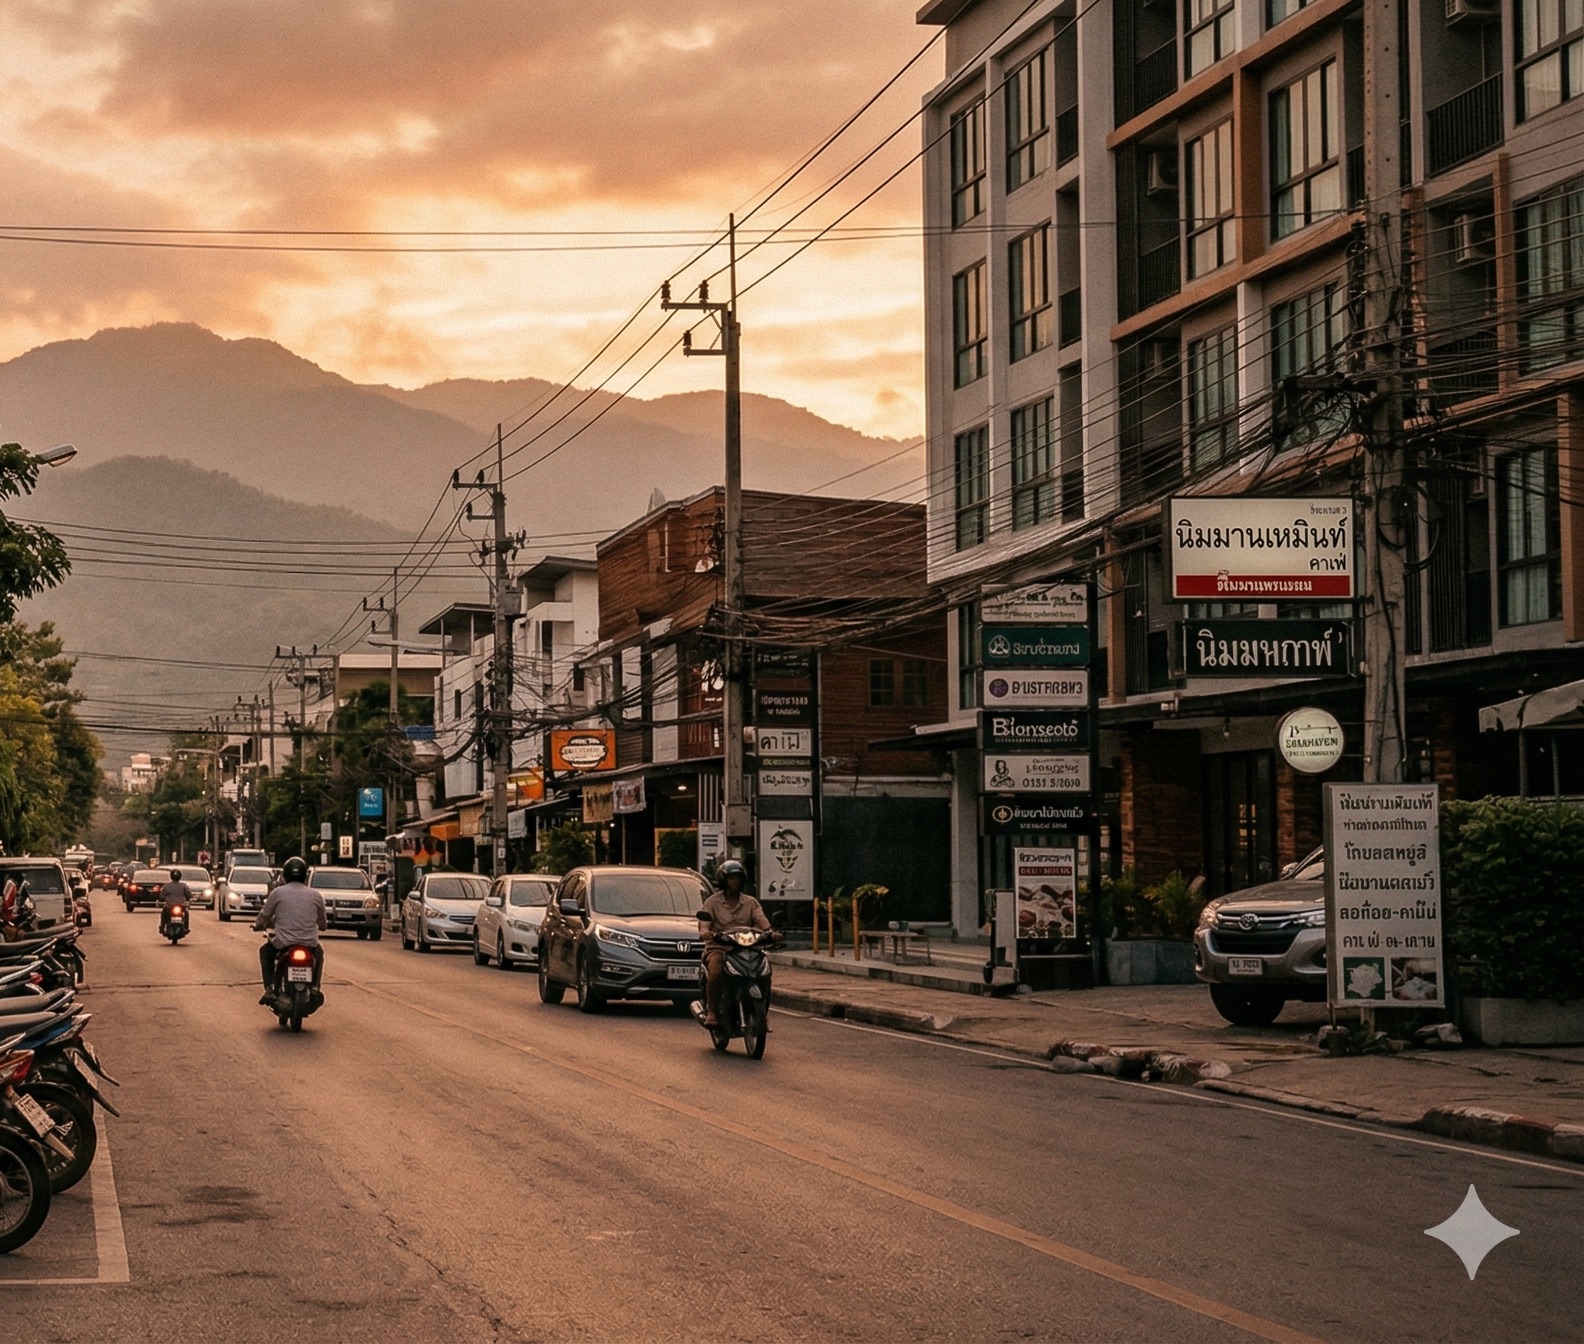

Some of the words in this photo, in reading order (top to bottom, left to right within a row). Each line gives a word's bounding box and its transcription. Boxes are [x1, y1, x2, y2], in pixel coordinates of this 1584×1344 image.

[1175, 517, 1348, 548] นิมมานเหมินท์
[1309, 552, 1347, 571] คาเฟ่
